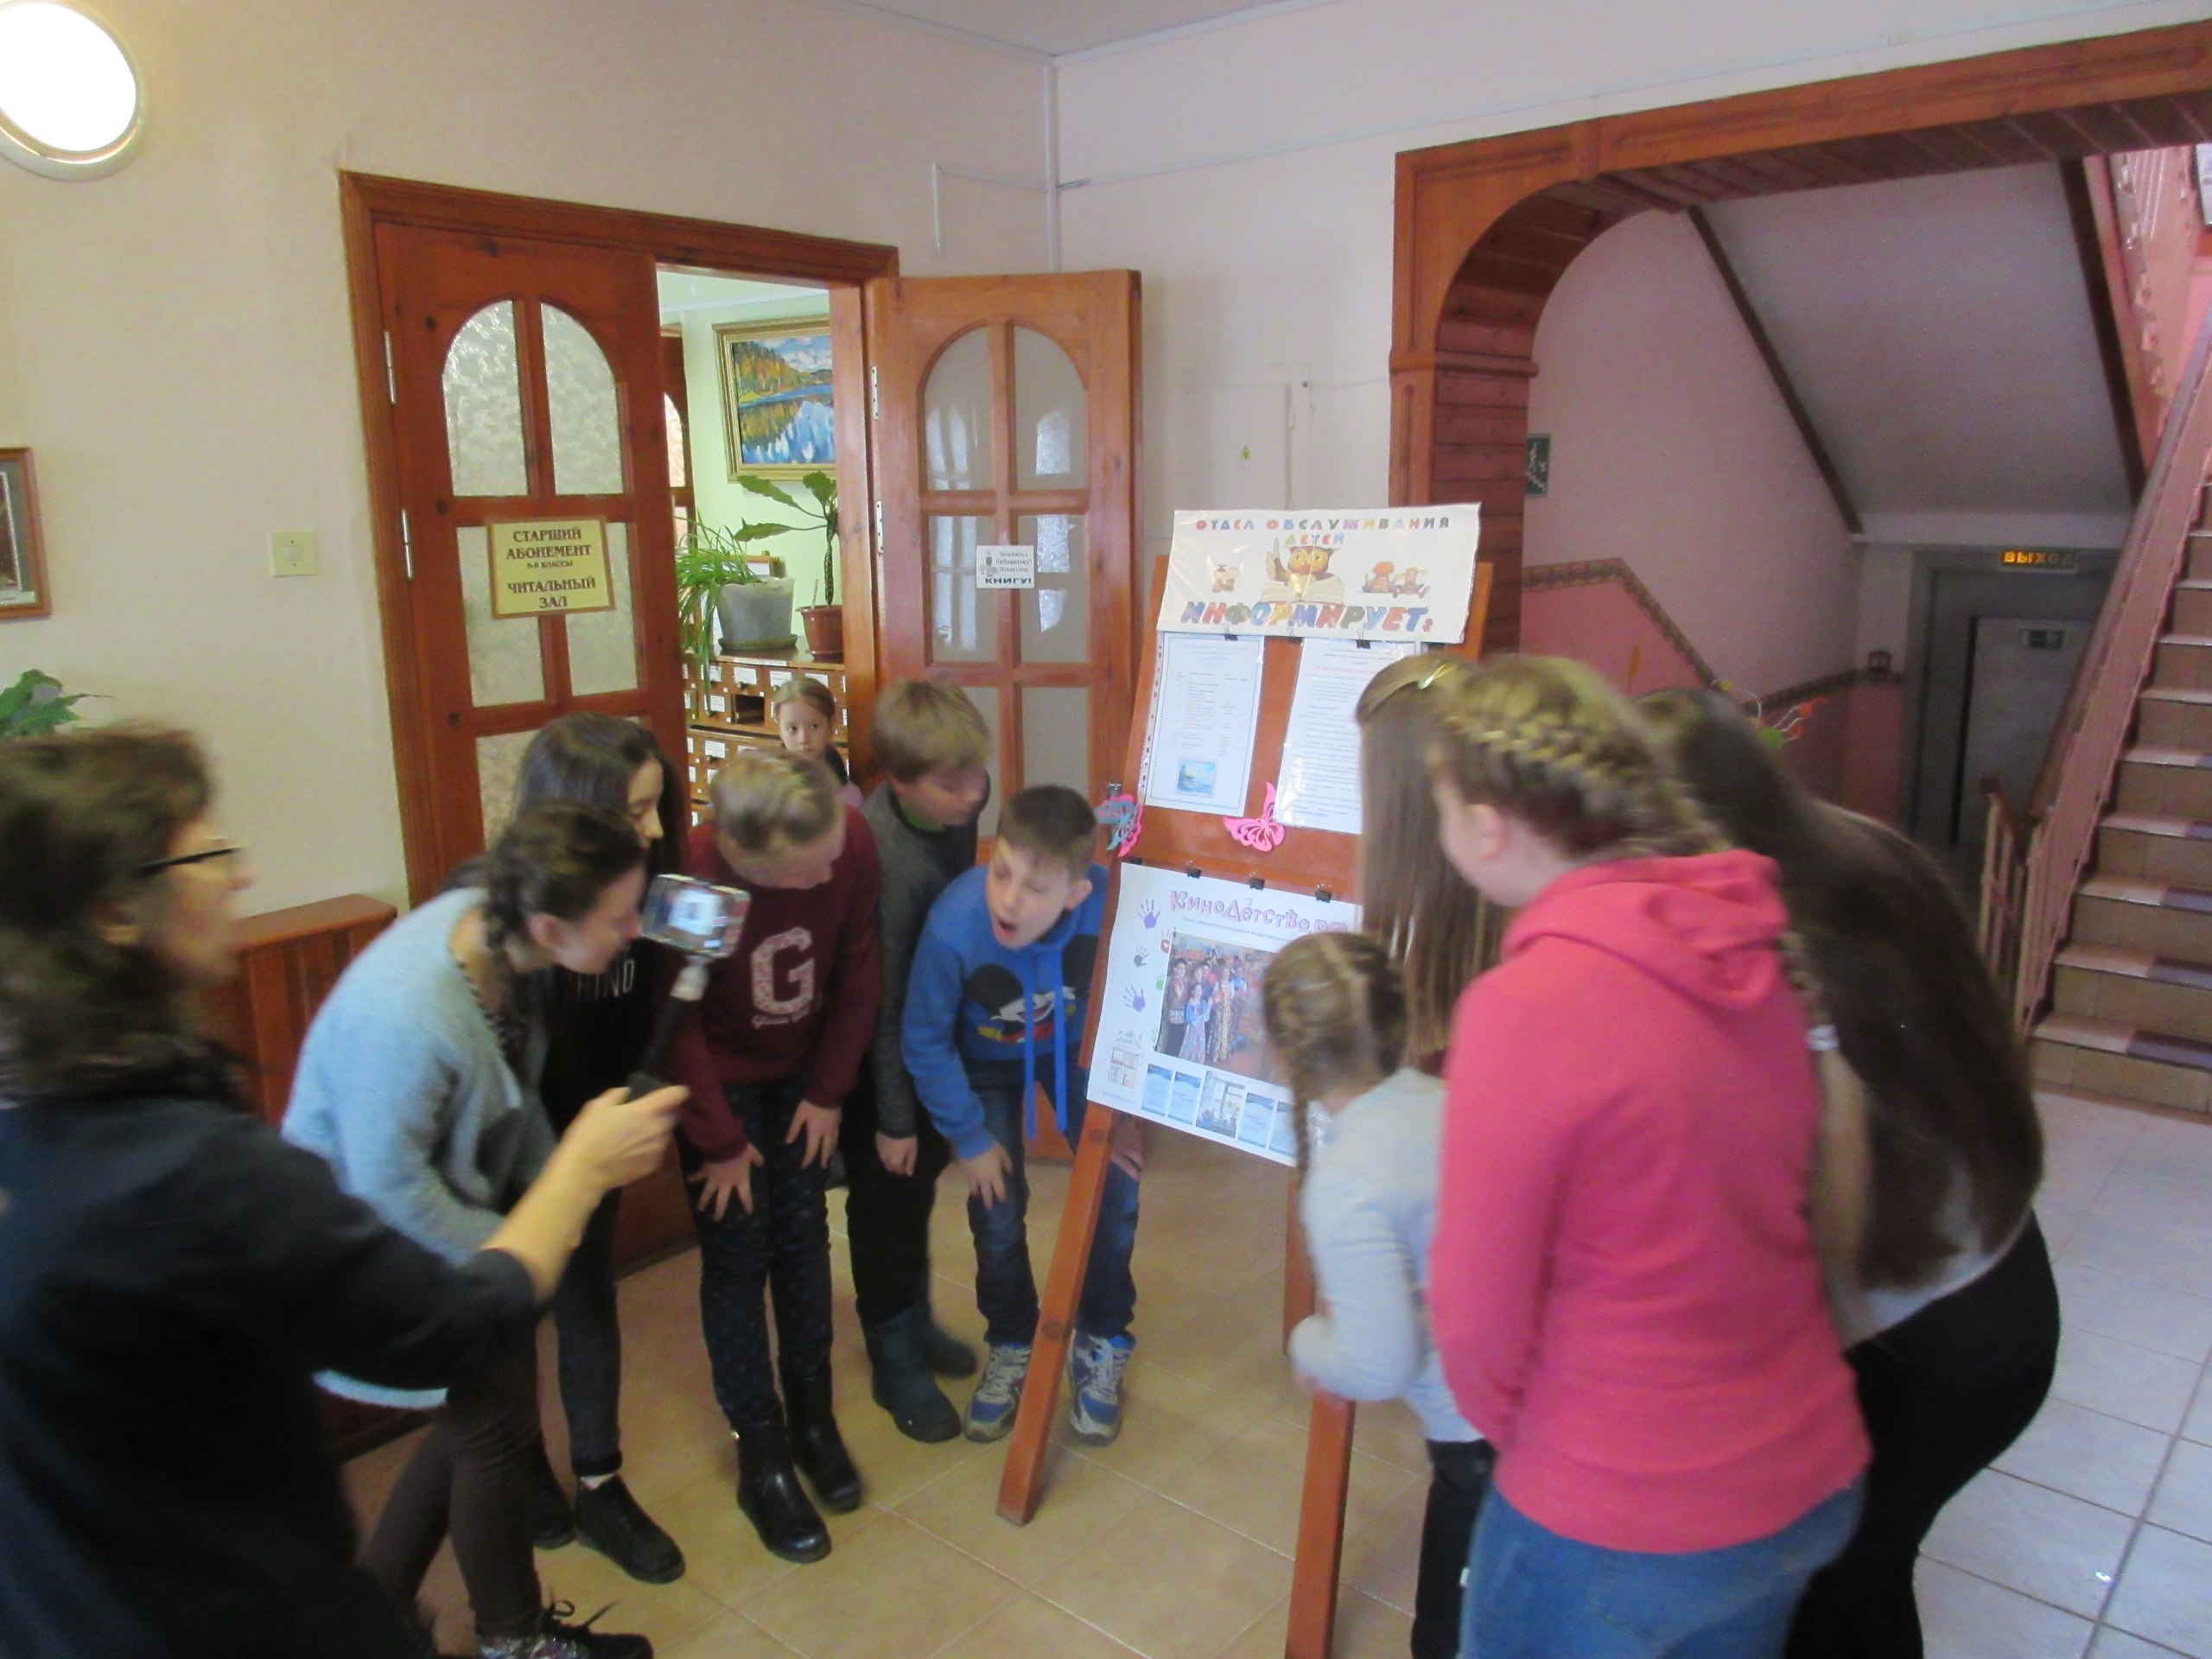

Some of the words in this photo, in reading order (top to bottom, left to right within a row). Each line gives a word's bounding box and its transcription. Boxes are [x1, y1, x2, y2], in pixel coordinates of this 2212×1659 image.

[1196, 518, 1255, 531] ОТДЕЛ
[1266, 517, 1450, 531] ОБСЛУЖИВАНИЯ
[512, 527, 582, 543] СТАРШИЙ
[1284, 532, 1345, 545] ДЕТЕЙ
[506, 544, 592, 560] АБОНЕМЕНТ
[541, 560, 574, 569] КЛАССЫ
[507, 575, 597, 594] ЧИТАЛЬНЫЙ
[539, 595, 569, 608] ЗАЛ
[1180, 601, 1433, 632] ИНФОРМИРУЕТ:
[750, 927, 816, 1014] G
